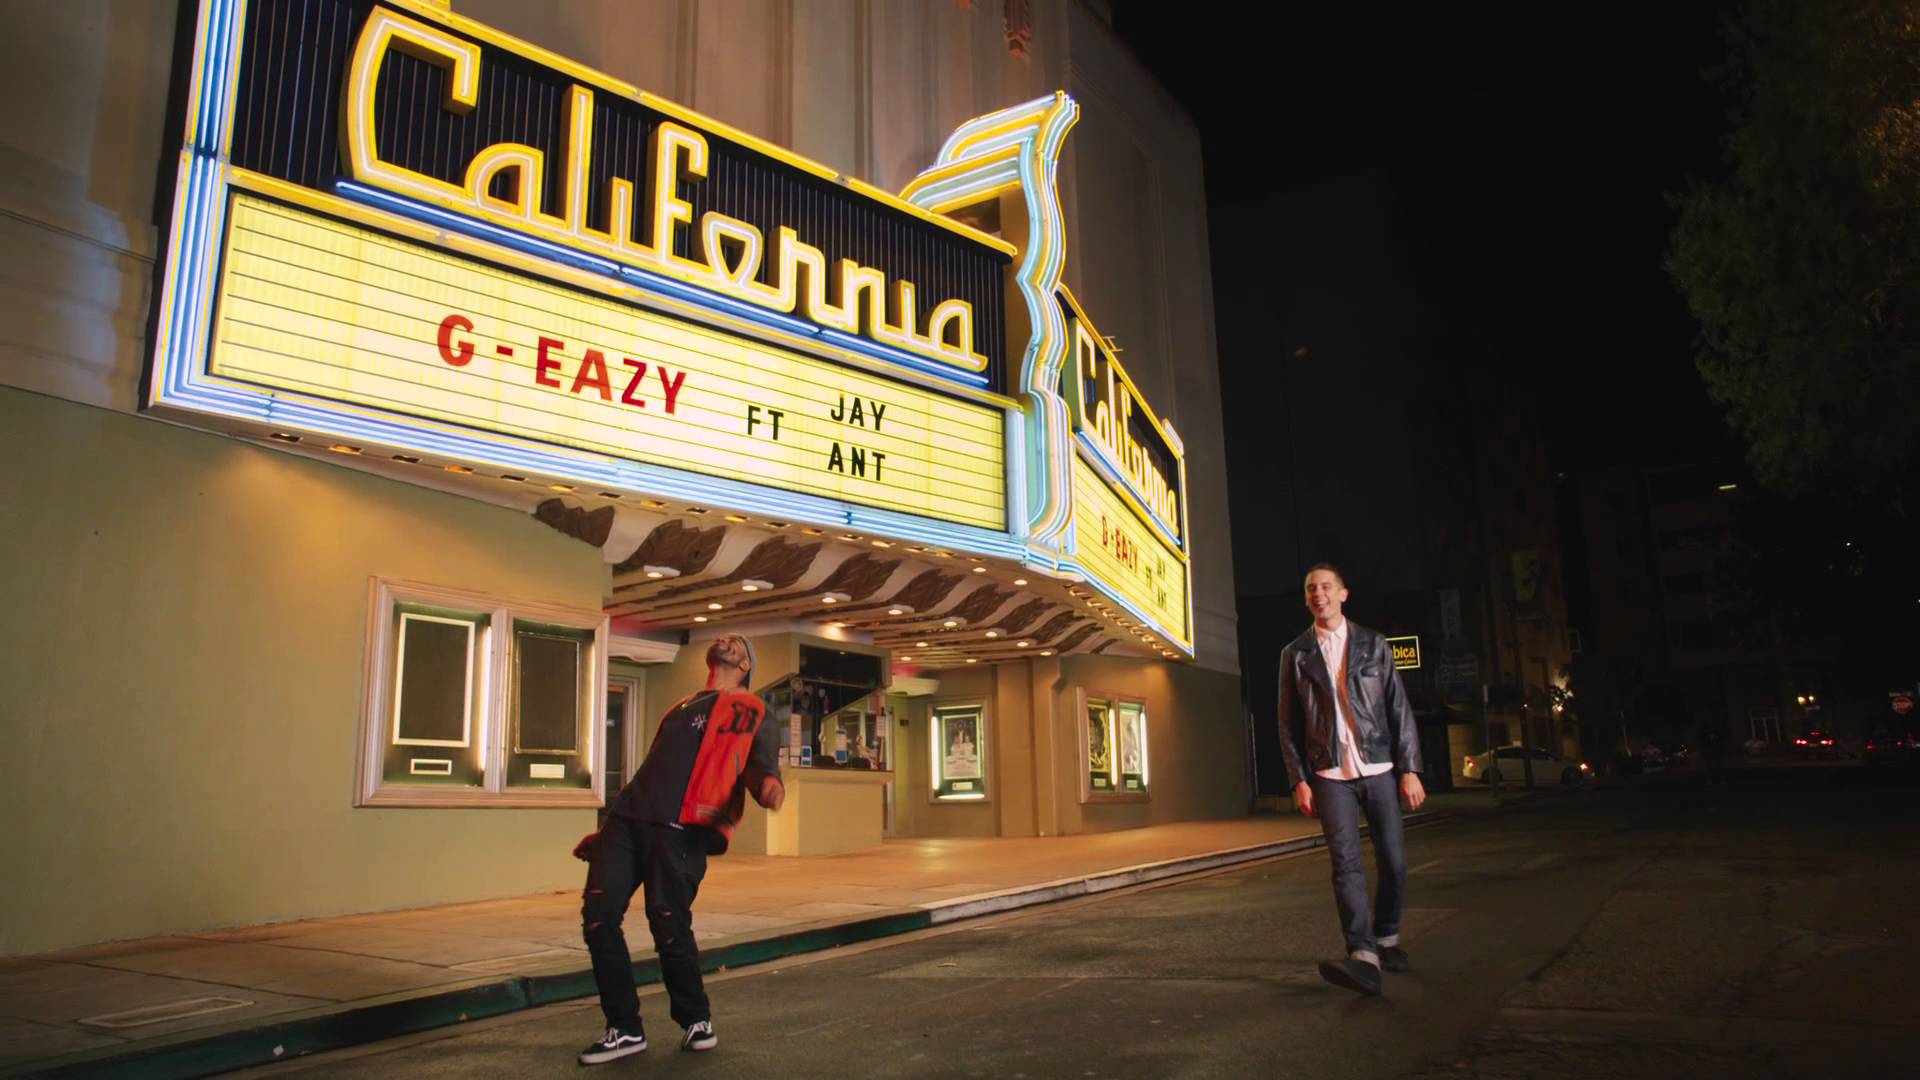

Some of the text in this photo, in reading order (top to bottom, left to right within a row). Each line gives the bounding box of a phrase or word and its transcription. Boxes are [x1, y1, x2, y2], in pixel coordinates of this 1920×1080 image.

[343, 5, 989, 373] California
[436, 313, 785, 441] G-EAZY FT
[830, 392, 886, 431] JAY
[827, 442, 886, 481] ANT
[1393, 644, 1416, 658] bica
